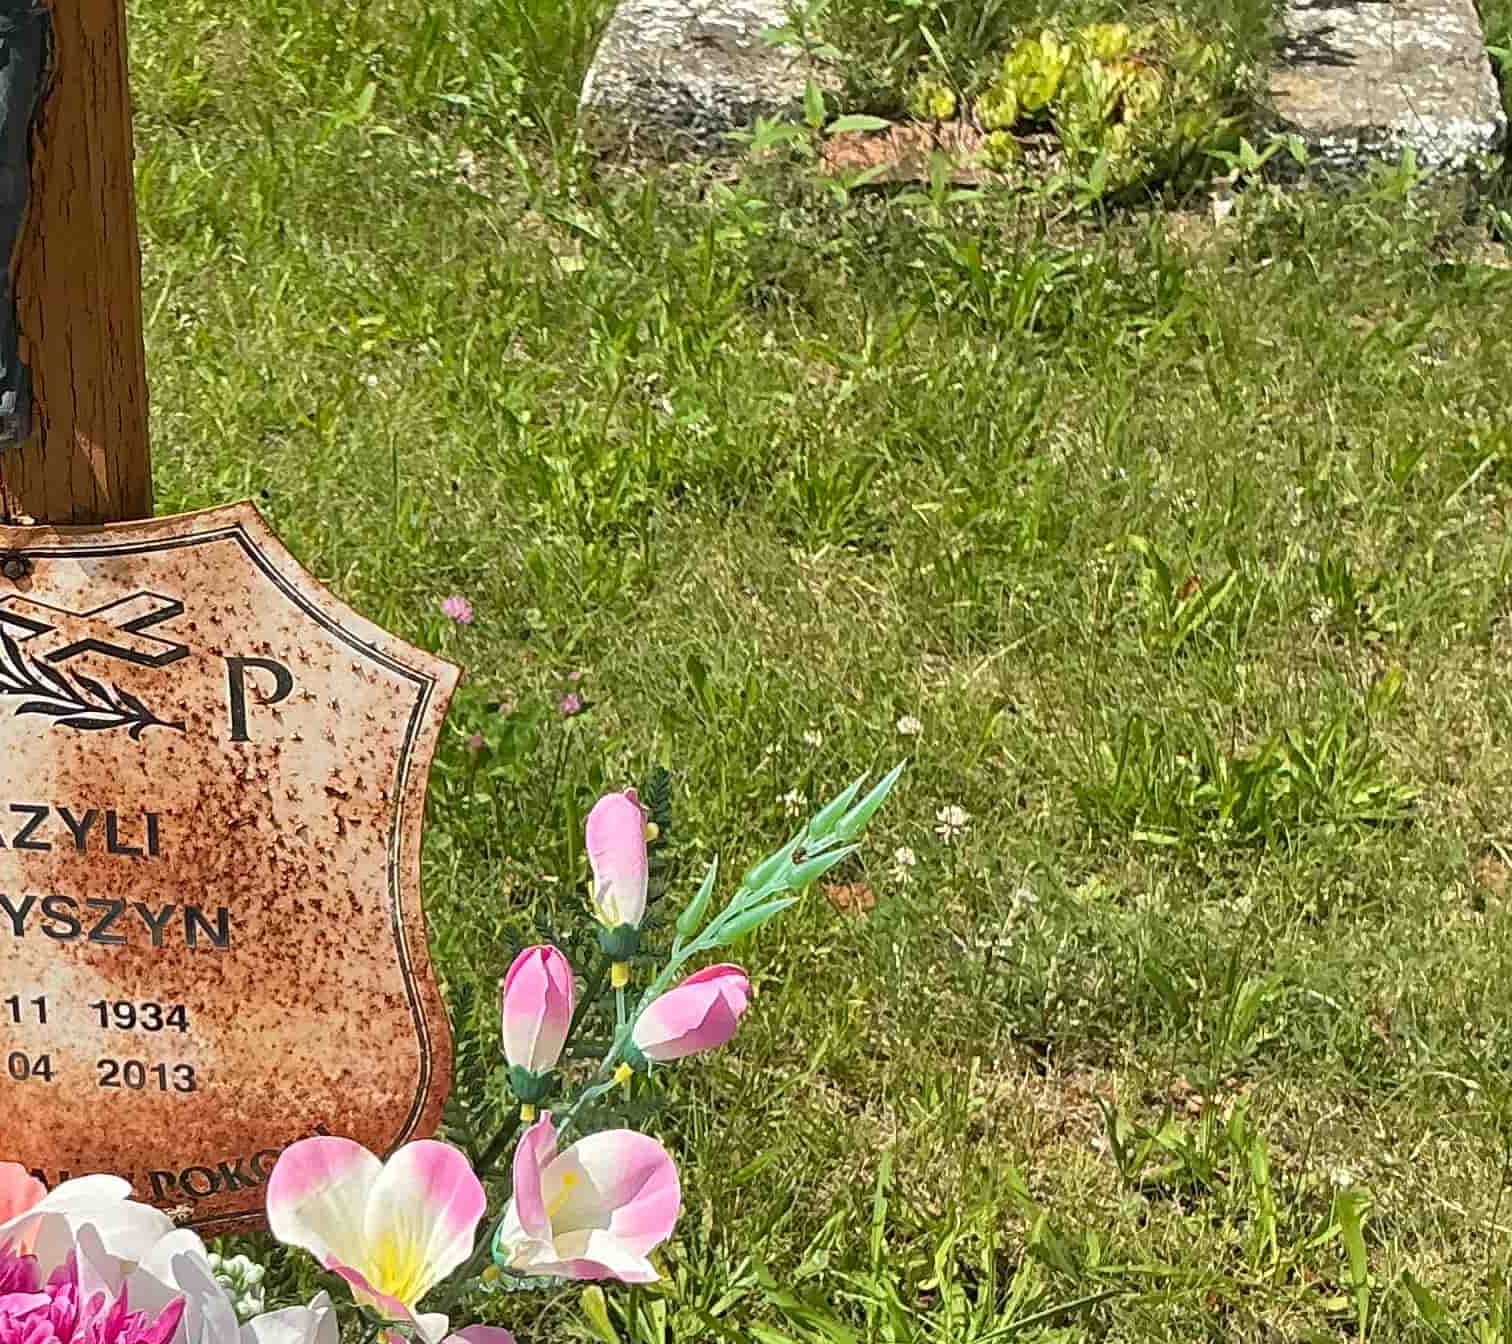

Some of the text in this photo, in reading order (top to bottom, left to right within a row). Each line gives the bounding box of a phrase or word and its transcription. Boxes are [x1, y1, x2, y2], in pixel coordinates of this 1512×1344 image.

[225, 657, 294, 742] P
[5, 994, 48, 1025] 11
[89, 999, 190, 1033] 1934
[8, 1051, 56, 1083] 04
[97, 1058, 197, 1093] 2013
